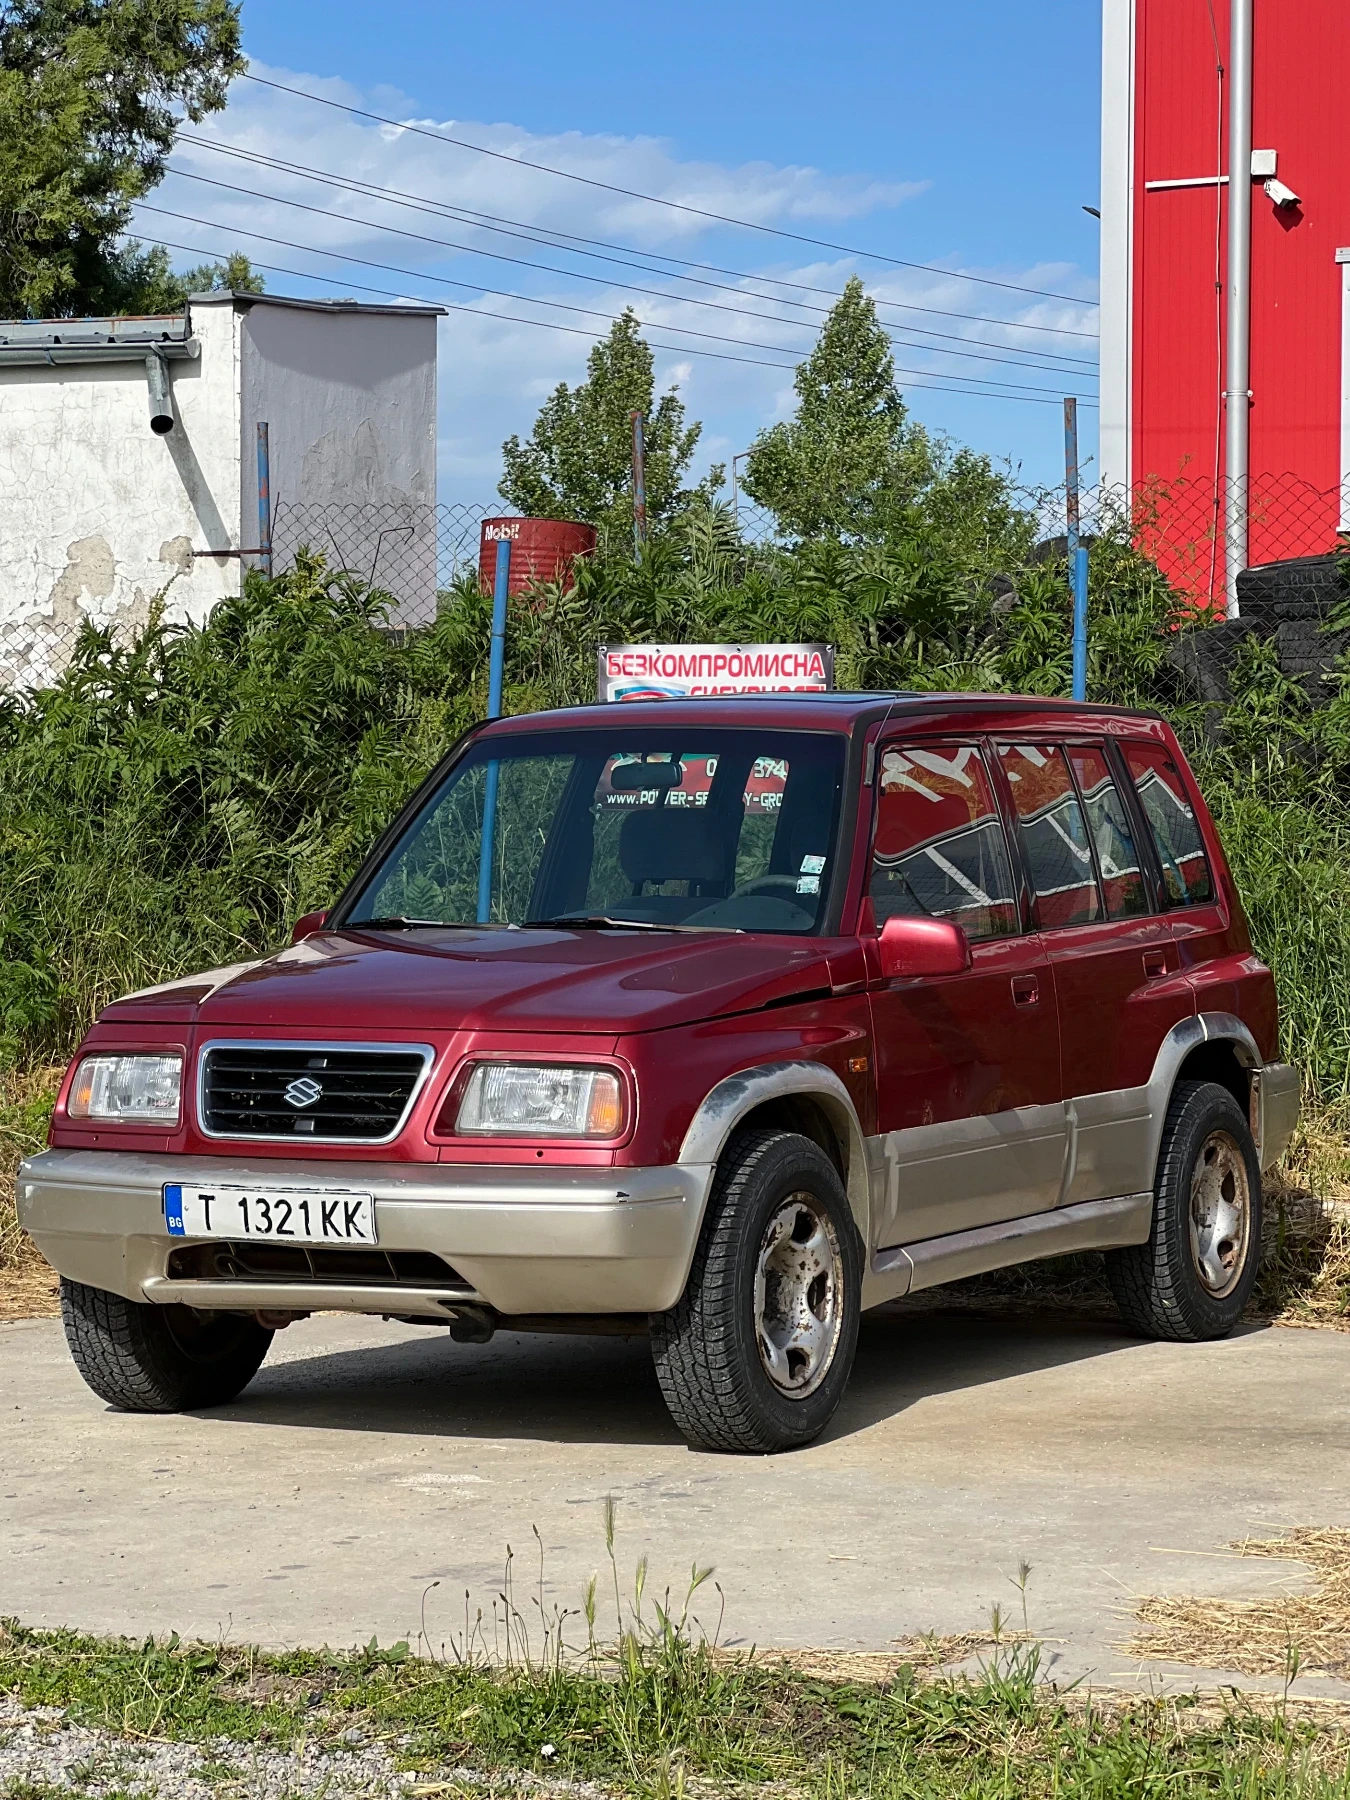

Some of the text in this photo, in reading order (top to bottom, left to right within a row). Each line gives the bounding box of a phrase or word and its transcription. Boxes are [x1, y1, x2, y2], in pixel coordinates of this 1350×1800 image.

[485, 524, 520, 541] Mobil
[607, 653, 825, 678] БЕЗКОМПРОМИСНА
[169, 1217, 182, 1227] BG
[198, 1194, 216, 1231] T
